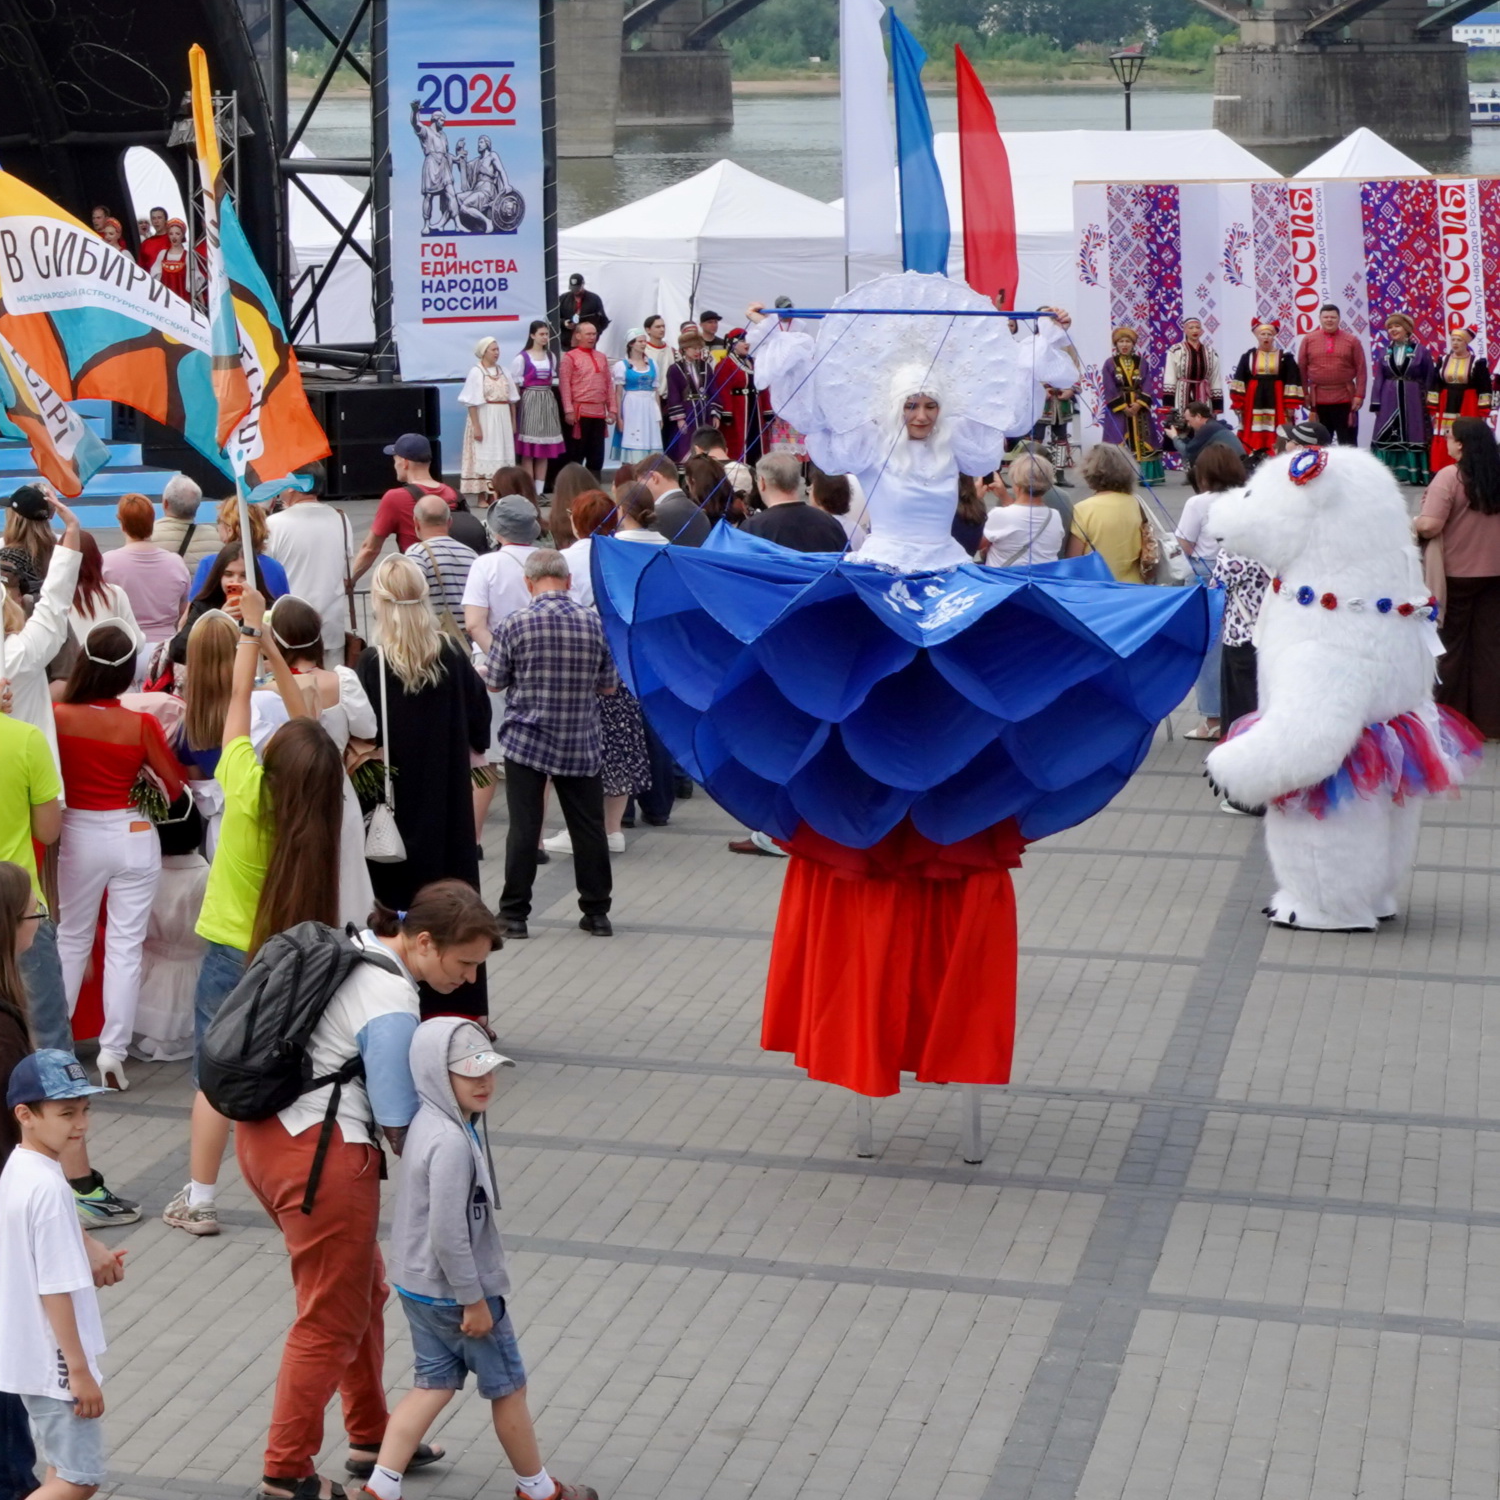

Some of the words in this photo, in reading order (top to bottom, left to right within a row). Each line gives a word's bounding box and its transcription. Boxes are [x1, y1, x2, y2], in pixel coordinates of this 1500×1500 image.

[418, 73, 517, 115] 2026
[0, 229, 24, 283] В
[421, 242, 457, 258] ГОД
[421, 259, 518, 277] ЕДИНСТВА
[421, 278, 509, 295] НАРОДОВ
[422, 296, 498, 312] РОССИИ
